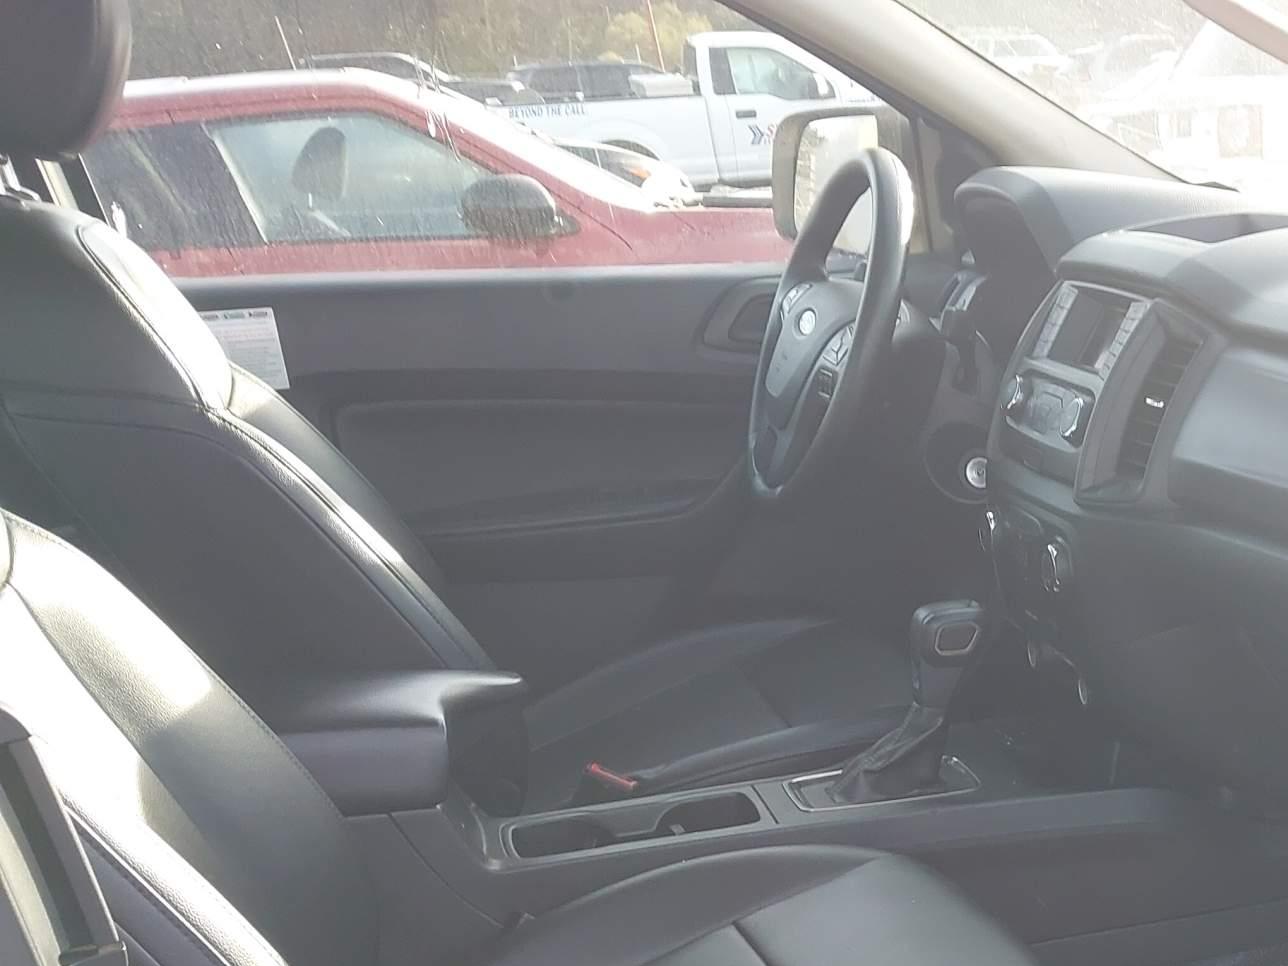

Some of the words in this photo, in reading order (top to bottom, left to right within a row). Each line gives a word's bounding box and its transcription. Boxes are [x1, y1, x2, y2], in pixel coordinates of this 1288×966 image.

[508, 106, 543, 119] BEYOND
[545, 105, 561, 117] THE
[565, 103, 585, 117] CALL
